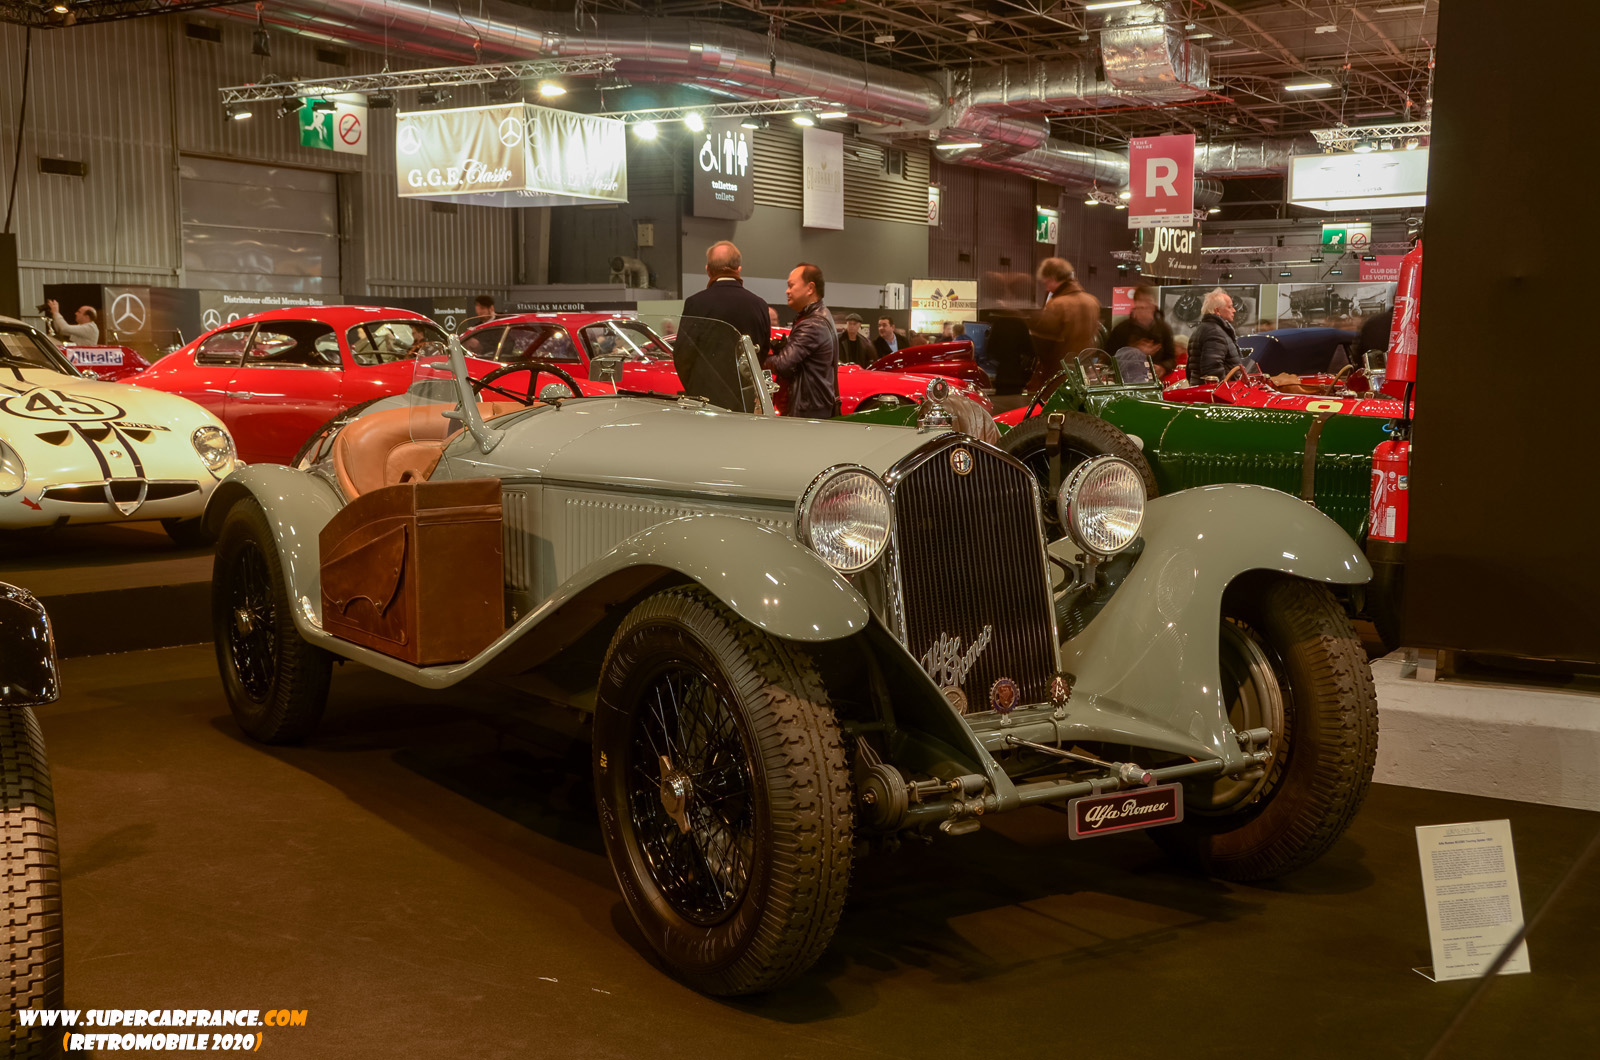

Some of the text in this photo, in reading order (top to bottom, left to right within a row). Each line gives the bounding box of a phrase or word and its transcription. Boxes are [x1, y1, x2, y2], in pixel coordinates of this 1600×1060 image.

[408, 158, 512, 188] G.G.E. Classic
[1145, 157, 1178, 197] R
[711, 180, 738, 191] toilettes
[715, 192, 735, 202] toilets
[223, 295, 323, 306] Distributeur officiel Mercedes-Benz
[70, 351, 123, 364] Alitalia
[944, 624, 993, 687] Romeo
[1085, 798, 1169, 828] Alfa Romeo
